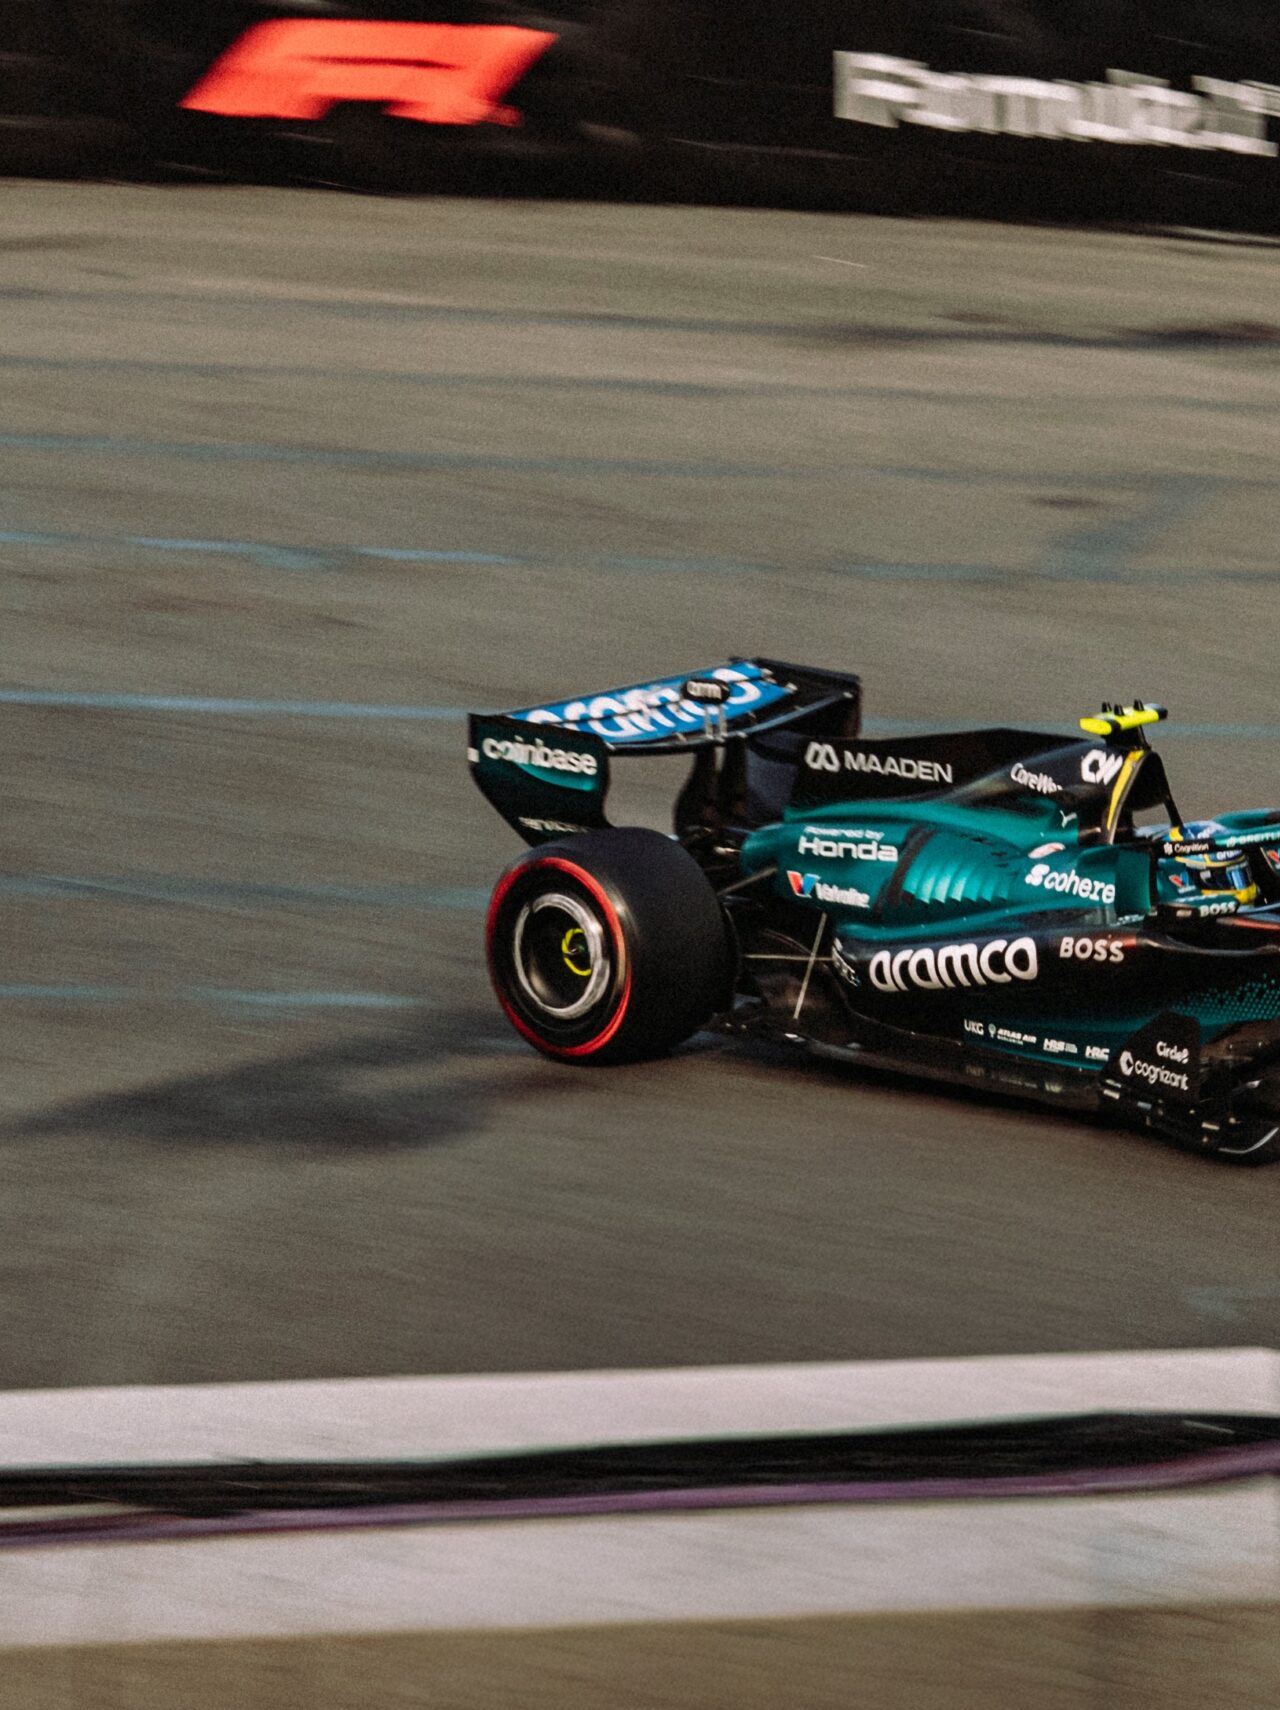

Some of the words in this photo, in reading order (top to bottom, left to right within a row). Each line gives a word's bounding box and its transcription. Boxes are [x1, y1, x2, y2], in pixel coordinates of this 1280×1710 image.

[482, 734, 598, 776] coinbase
[843, 750, 954, 784] MAADEN
[798, 835, 899, 863] Honda
[1044, 868, 1116, 904] cohere
[1199, 901, 1238, 917] BOSS
[869, 936, 1039, 993] aramco
[1060, 936, 1125, 963] BOSS
[963, 1018, 985, 1036] UKG
[1134, 1060, 1189, 1091] cognizant
